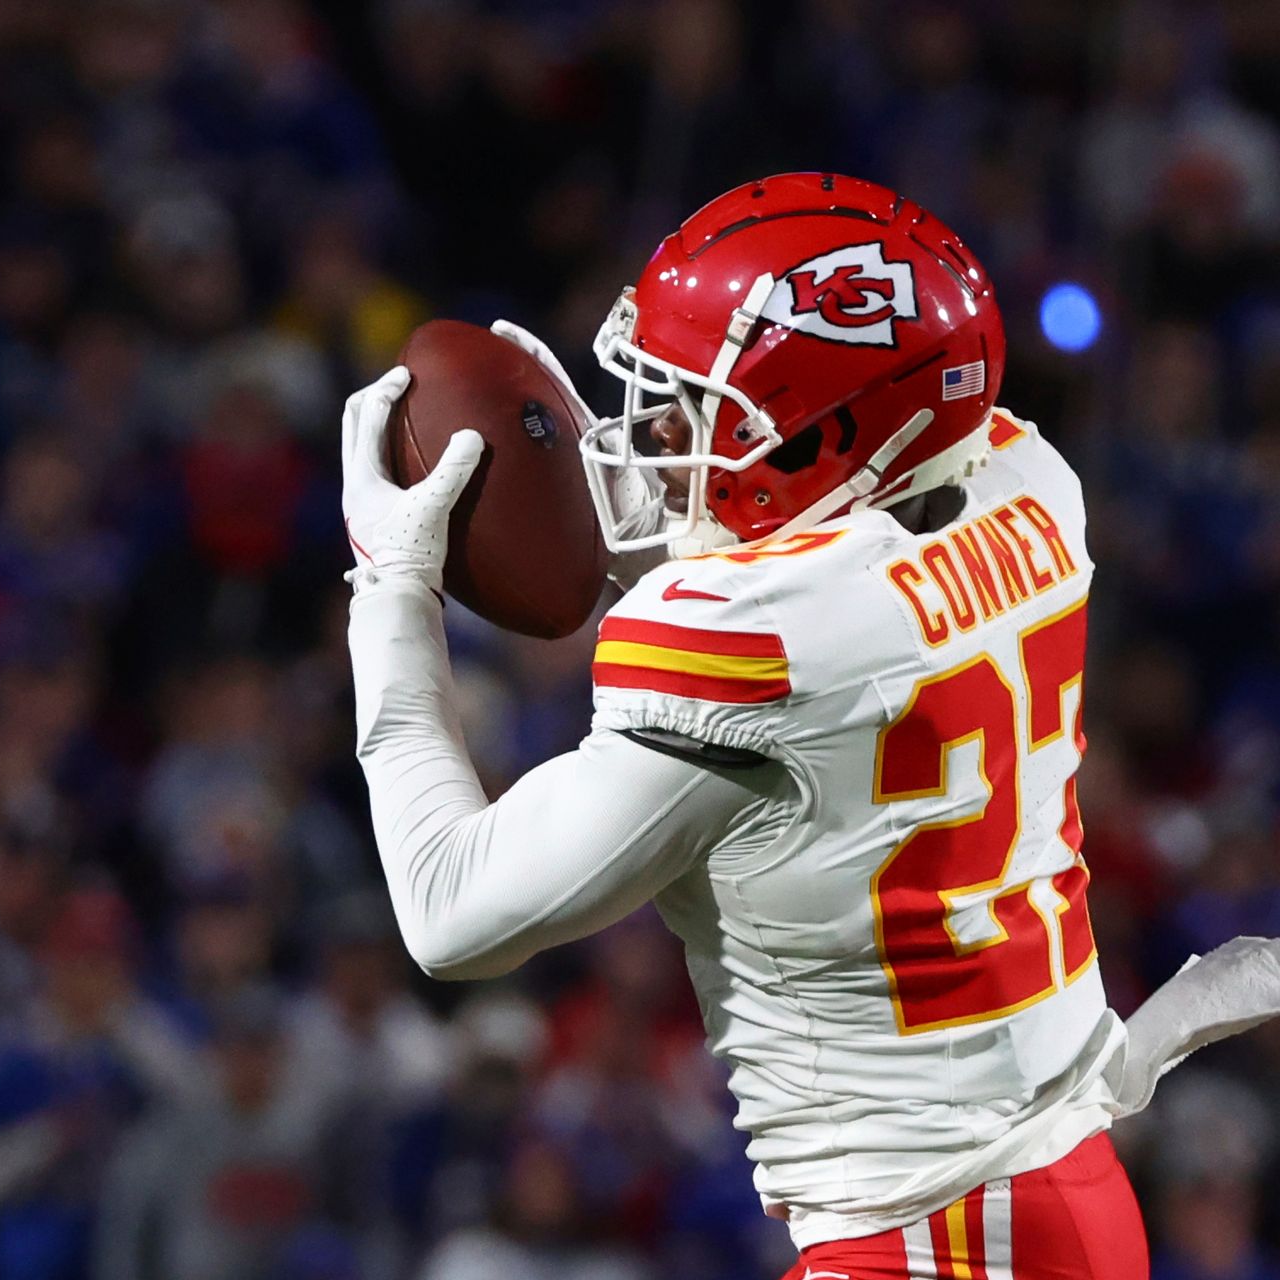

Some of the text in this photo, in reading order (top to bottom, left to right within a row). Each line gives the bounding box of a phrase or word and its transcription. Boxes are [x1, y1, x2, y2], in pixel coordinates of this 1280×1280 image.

[787, 265, 895, 329] KC
[887, 494, 1077, 648] CONNER
[871, 597, 1097, 1035] 27
